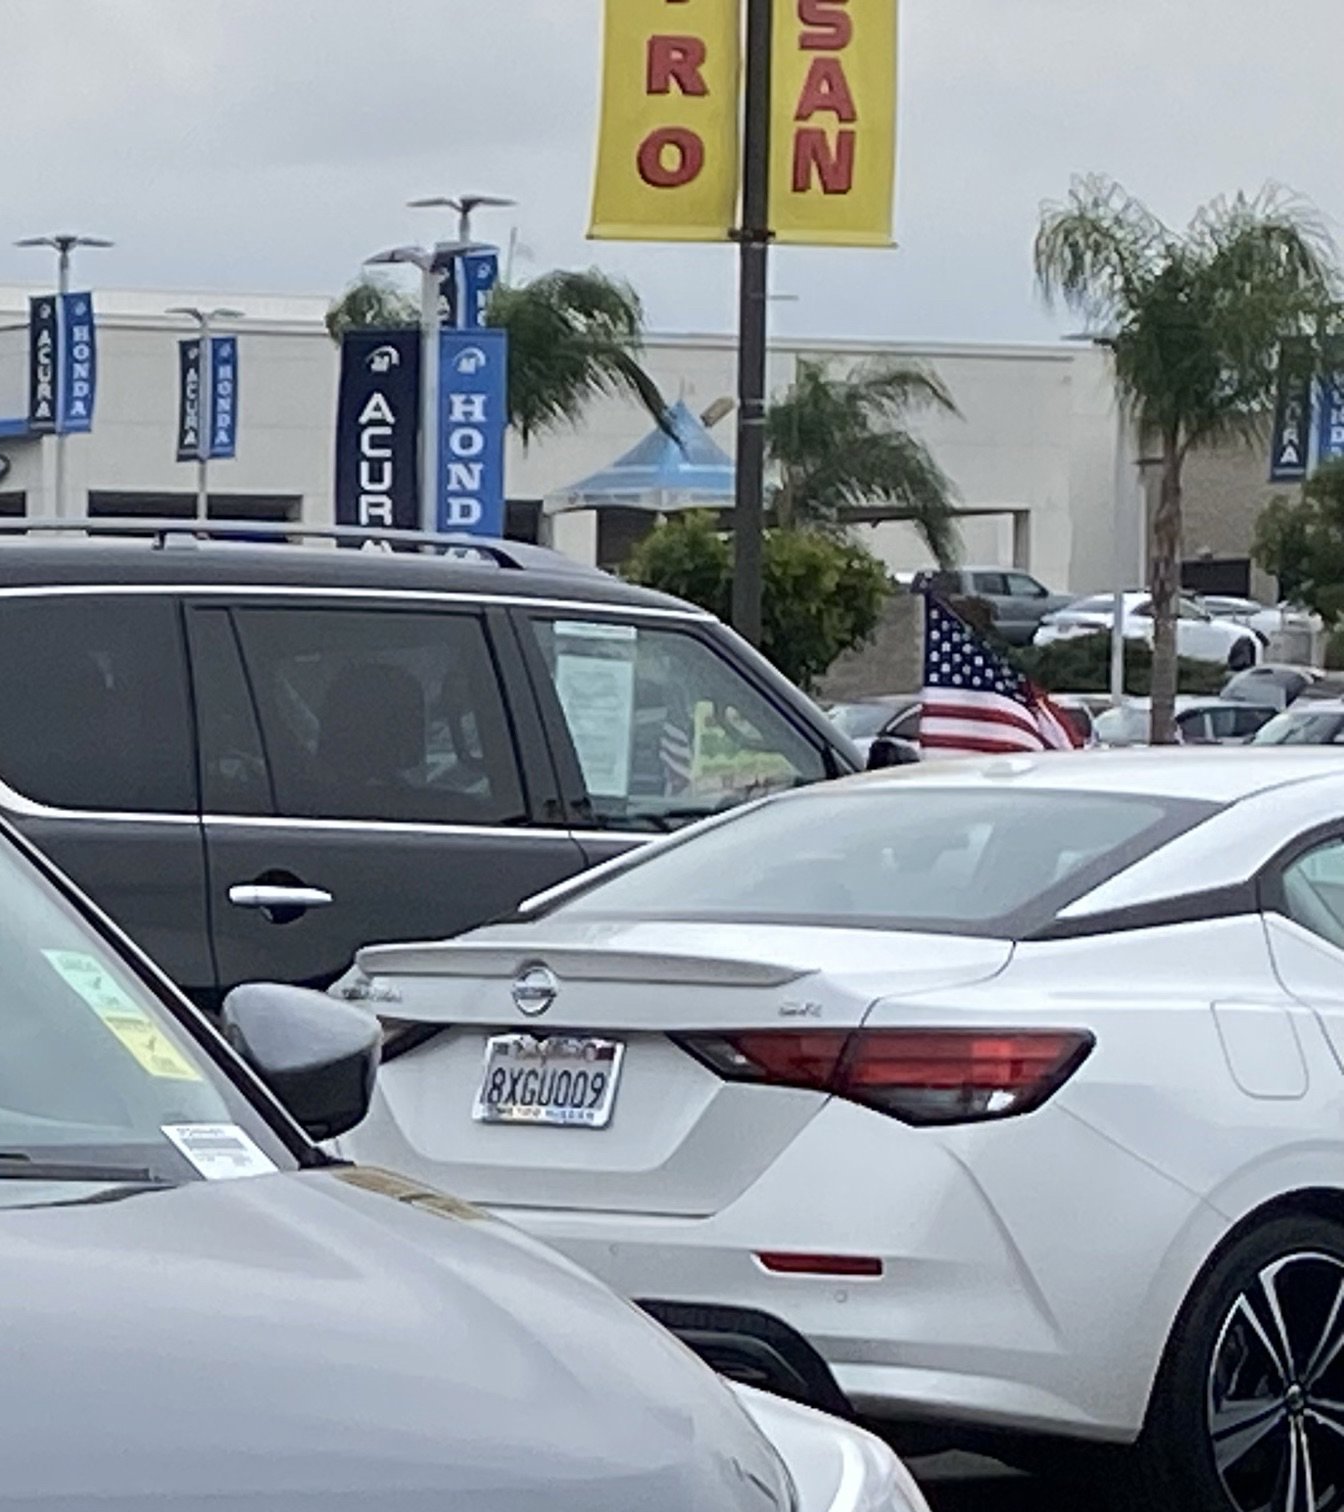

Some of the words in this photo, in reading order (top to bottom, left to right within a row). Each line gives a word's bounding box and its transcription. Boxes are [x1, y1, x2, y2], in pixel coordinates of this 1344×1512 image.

[791, 0, 858, 194] SAN
[35, 329, 53, 417] ACURA
[70, 325, 90, 416] HONDA
[184, 367, 199, 445] ACURA
[214, 365, 233, 443] HONDA
[447, 393, 487, 558] HOND
[487, 1067, 607, 1109] 8XGU009
